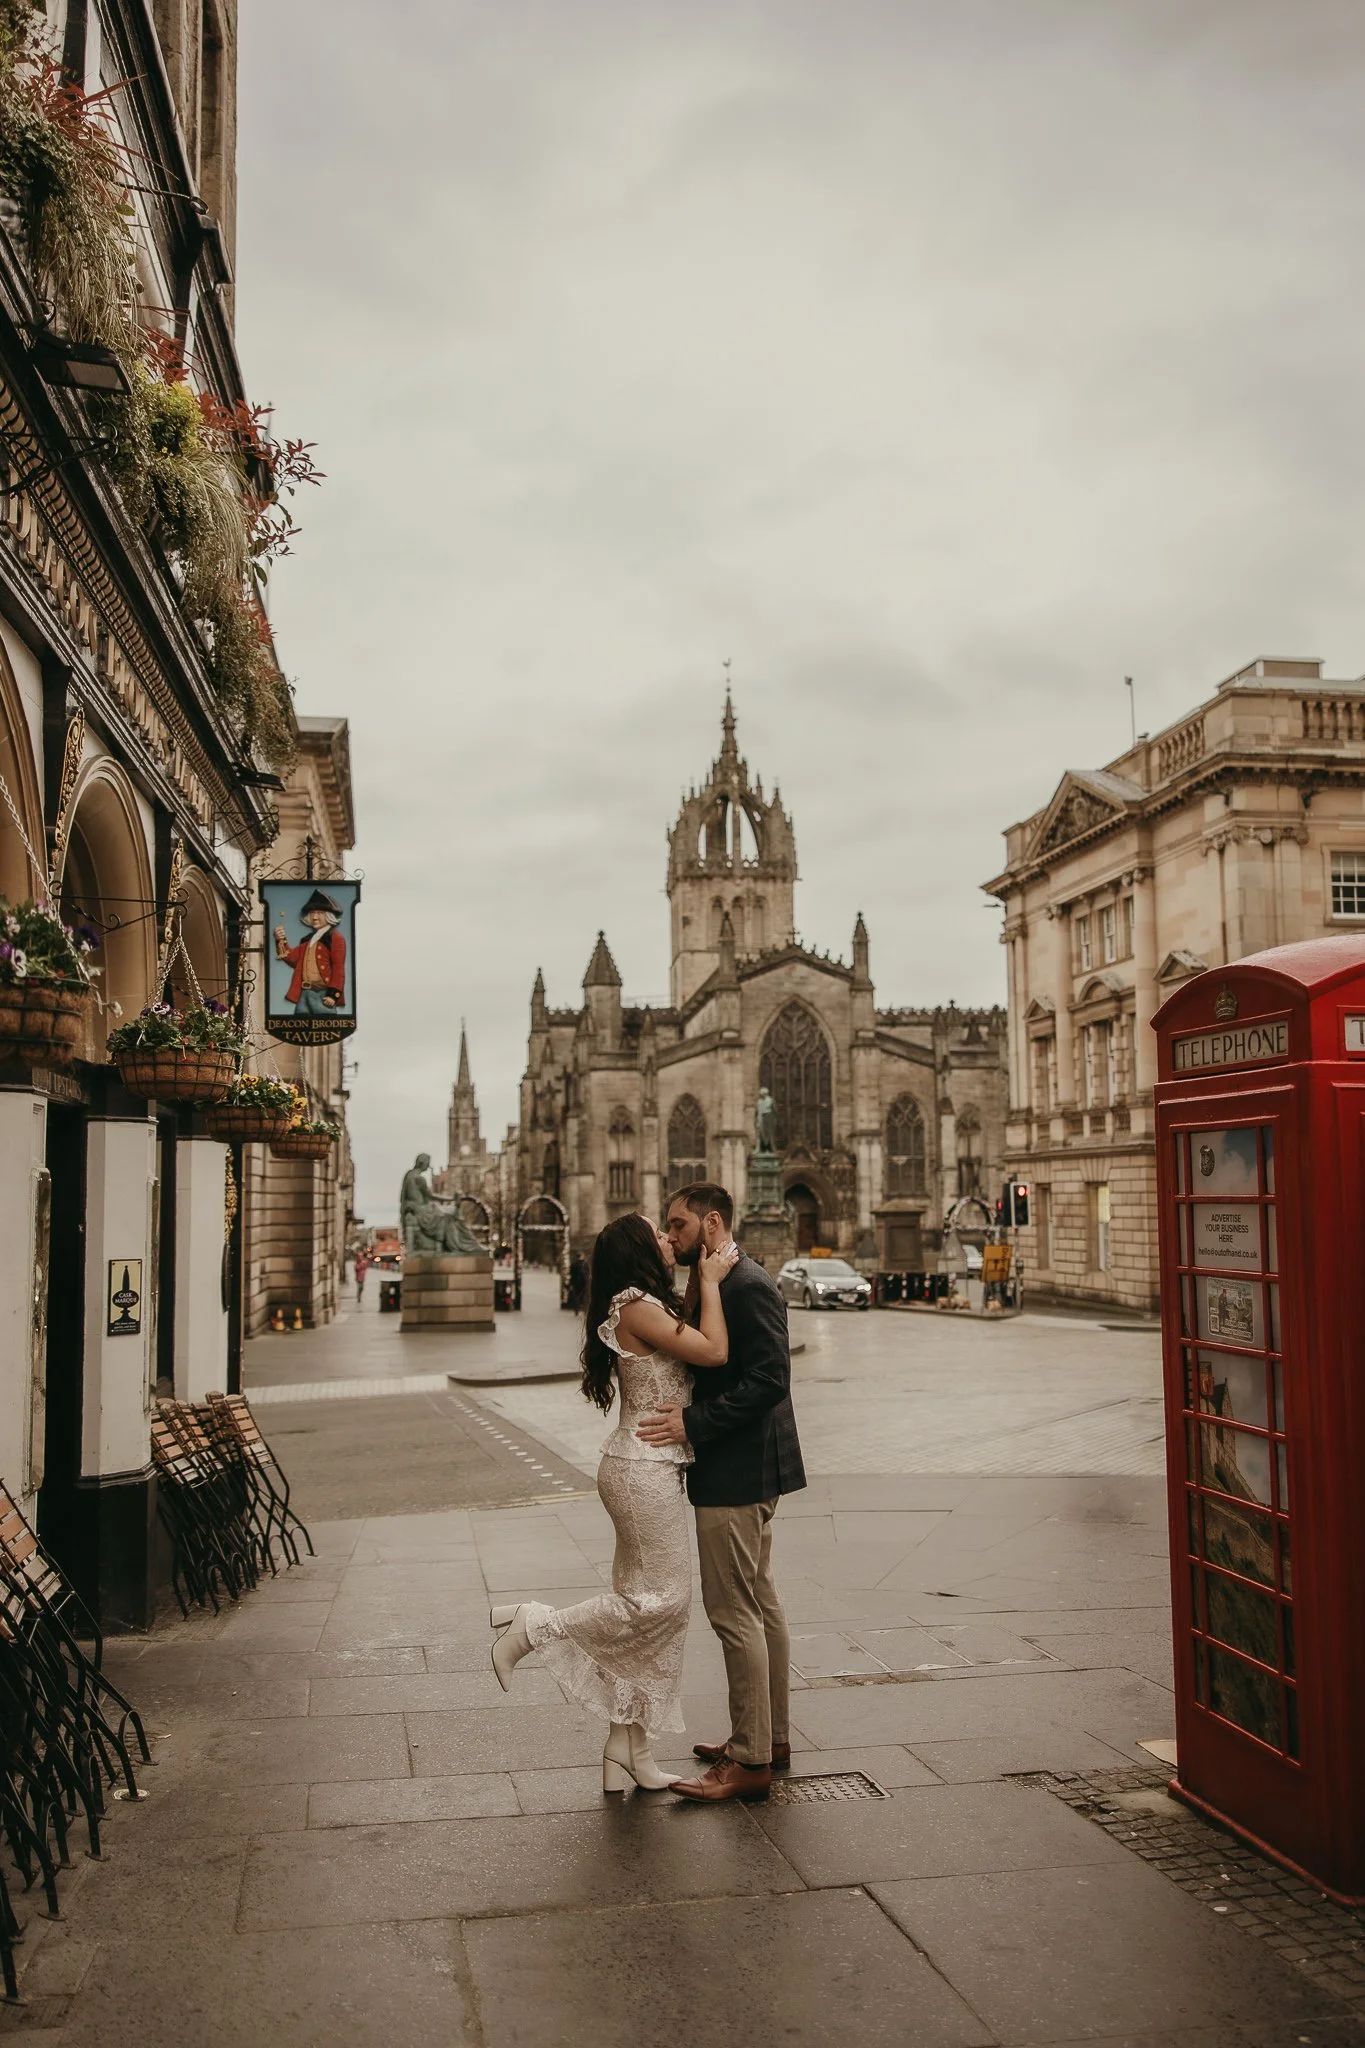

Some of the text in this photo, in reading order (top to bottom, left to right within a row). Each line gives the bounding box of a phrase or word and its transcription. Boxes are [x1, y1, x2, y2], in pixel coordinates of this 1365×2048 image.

[8, 461, 98, 656] DEACON
[268, 1019, 355, 1029] DEACON BRODIE'S
[282, 1031, 341, 1042] TAVERN
[1179, 1025, 1287, 1068] TELEPHONE
[1211, 1214, 1242, 1223] ADVERTISE
[1205, 1223, 1249, 1233] YOUR BUSINESS
[1218, 1234, 1233, 1243] HERE
